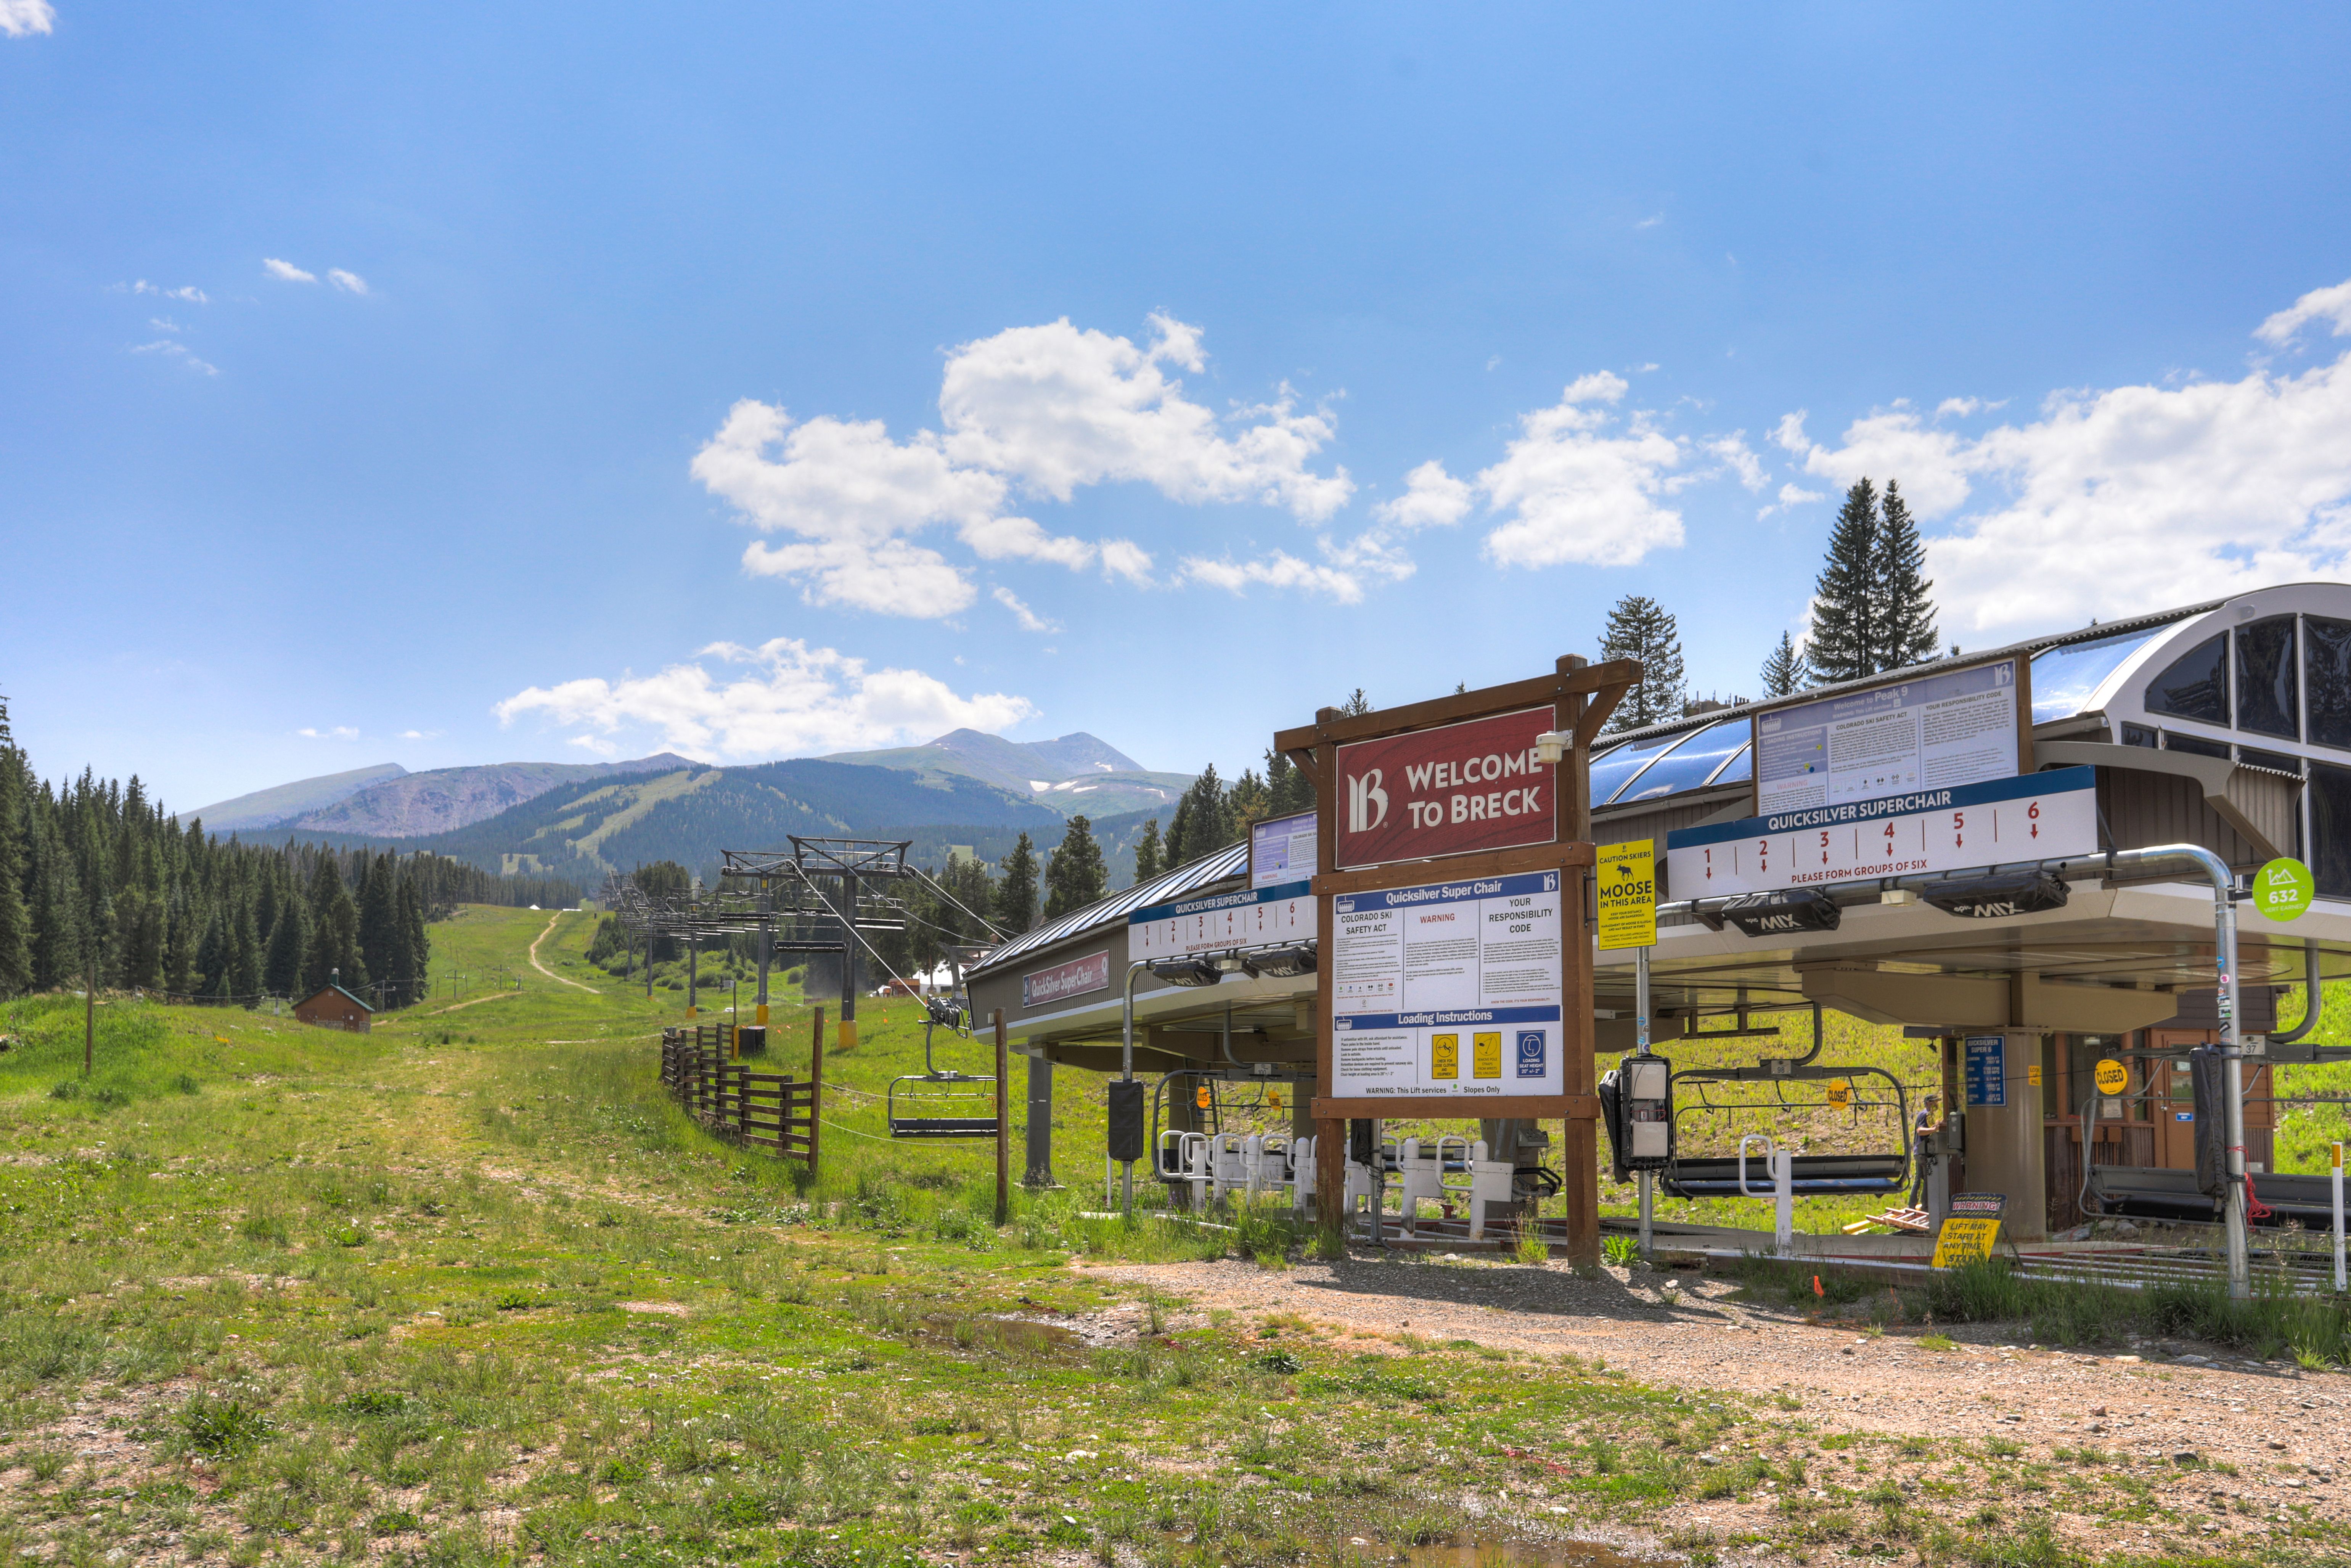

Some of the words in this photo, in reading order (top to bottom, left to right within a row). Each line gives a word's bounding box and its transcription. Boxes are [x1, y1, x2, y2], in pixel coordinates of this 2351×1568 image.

[1834, 699, 1864, 710] Welcome
[1875, 688, 1899, 702] Peak
[1901, 686, 1907, 697] 9
[1942, 694, 1985, 707] RESPONSIBILITY
[1837, 720, 1864, 730] COLORADO
[1876, 714, 1895, 722] SAFETY
[1764, 736, 1785, 744] LOADING
[1787, 729, 1822, 740] INSTRUCTIONS
[1406, 747, 1543, 792] WELCOME
[1777, 779, 1807, 790] WARNING
[1408, 801, 1443, 829] TO
[1451, 786, 1541, 824] BRECK
[1768, 805, 1856, 831] QUICKSILVER
[1859, 791, 1951, 817] SUPERCHAIR
[1705, 849, 1710, 863] 1
[1760, 840, 1768, 855] 2
[1820, 832, 1829, 847] 3
[1884, 822, 1894, 838] 4
[1954, 813, 1964, 829] 5
[2028, 802, 2039, 819] 6
[1599, 854, 1628, 864] CAUTION
[1630, 851, 1651, 859] SKIERS
[1792, 872, 1822, 884] PLEASE
[1826, 869, 1851, 879] FORM
[1855, 863, 1893, 876] GROUPS
[1896, 861, 1908, 870] OF
[1912, 860, 1927, 869] SIX
[1387, 889, 1439, 905] Quicksilver
[1442, 885, 1472, 899] Super
[1474, 881, 1502, 894] Chair
[1600, 880, 1652, 899] MOOSE
[2269, 889, 2298, 904] 632
[1176, 900, 1215, 914] QUICKSILVER
[1217, 892, 1257, 906] SUPERCHAIR
[1510, 898, 1531, 907] YOUR
[1601, 900, 1608, 909] IN
[1610, 898, 1629, 907] THIS
[1631, 896, 1652, 905] AREA
[1974, 901, 2025, 917] MIX
[1146, 925, 1148, 935] 1
[1171, 921, 1175, 931] 2
[1199, 917, 1203, 927] 3
[1228, 912, 1232, 922] 4
[1258, 907, 1262, 918] 5
[1290, 902, 1294, 913] 6
[1342, 913, 1378, 923] COLORADO
[1420, 913, 1455, 923] WARNING
[1490, 909, 1552, 922] RESPONSIBILITY
[1761, 914, 1802, 929] MIX
[1346, 925, 1372, 934] SAFETY
[1510, 924, 1531, 933] CODE
[1214, 940, 1231, 948] GROUPS
[1101, 956, 1107, 976] 9
[1273, 966, 1299, 976] MIX
[1032, 975, 1060, 997] QuickSilver
[1061, 966, 1092, 993] SuperChair
[1398, 1014, 1434, 1025] Loading
[1437, 1011, 1492, 1022] Instructions
[2246, 1046, 2256, 1054] 37
[2097, 1069, 2123, 1085] CLOSED
[1829, 1090, 1847, 1102] CLOSED
[1952, 1202, 2000, 1211] WARNING!
